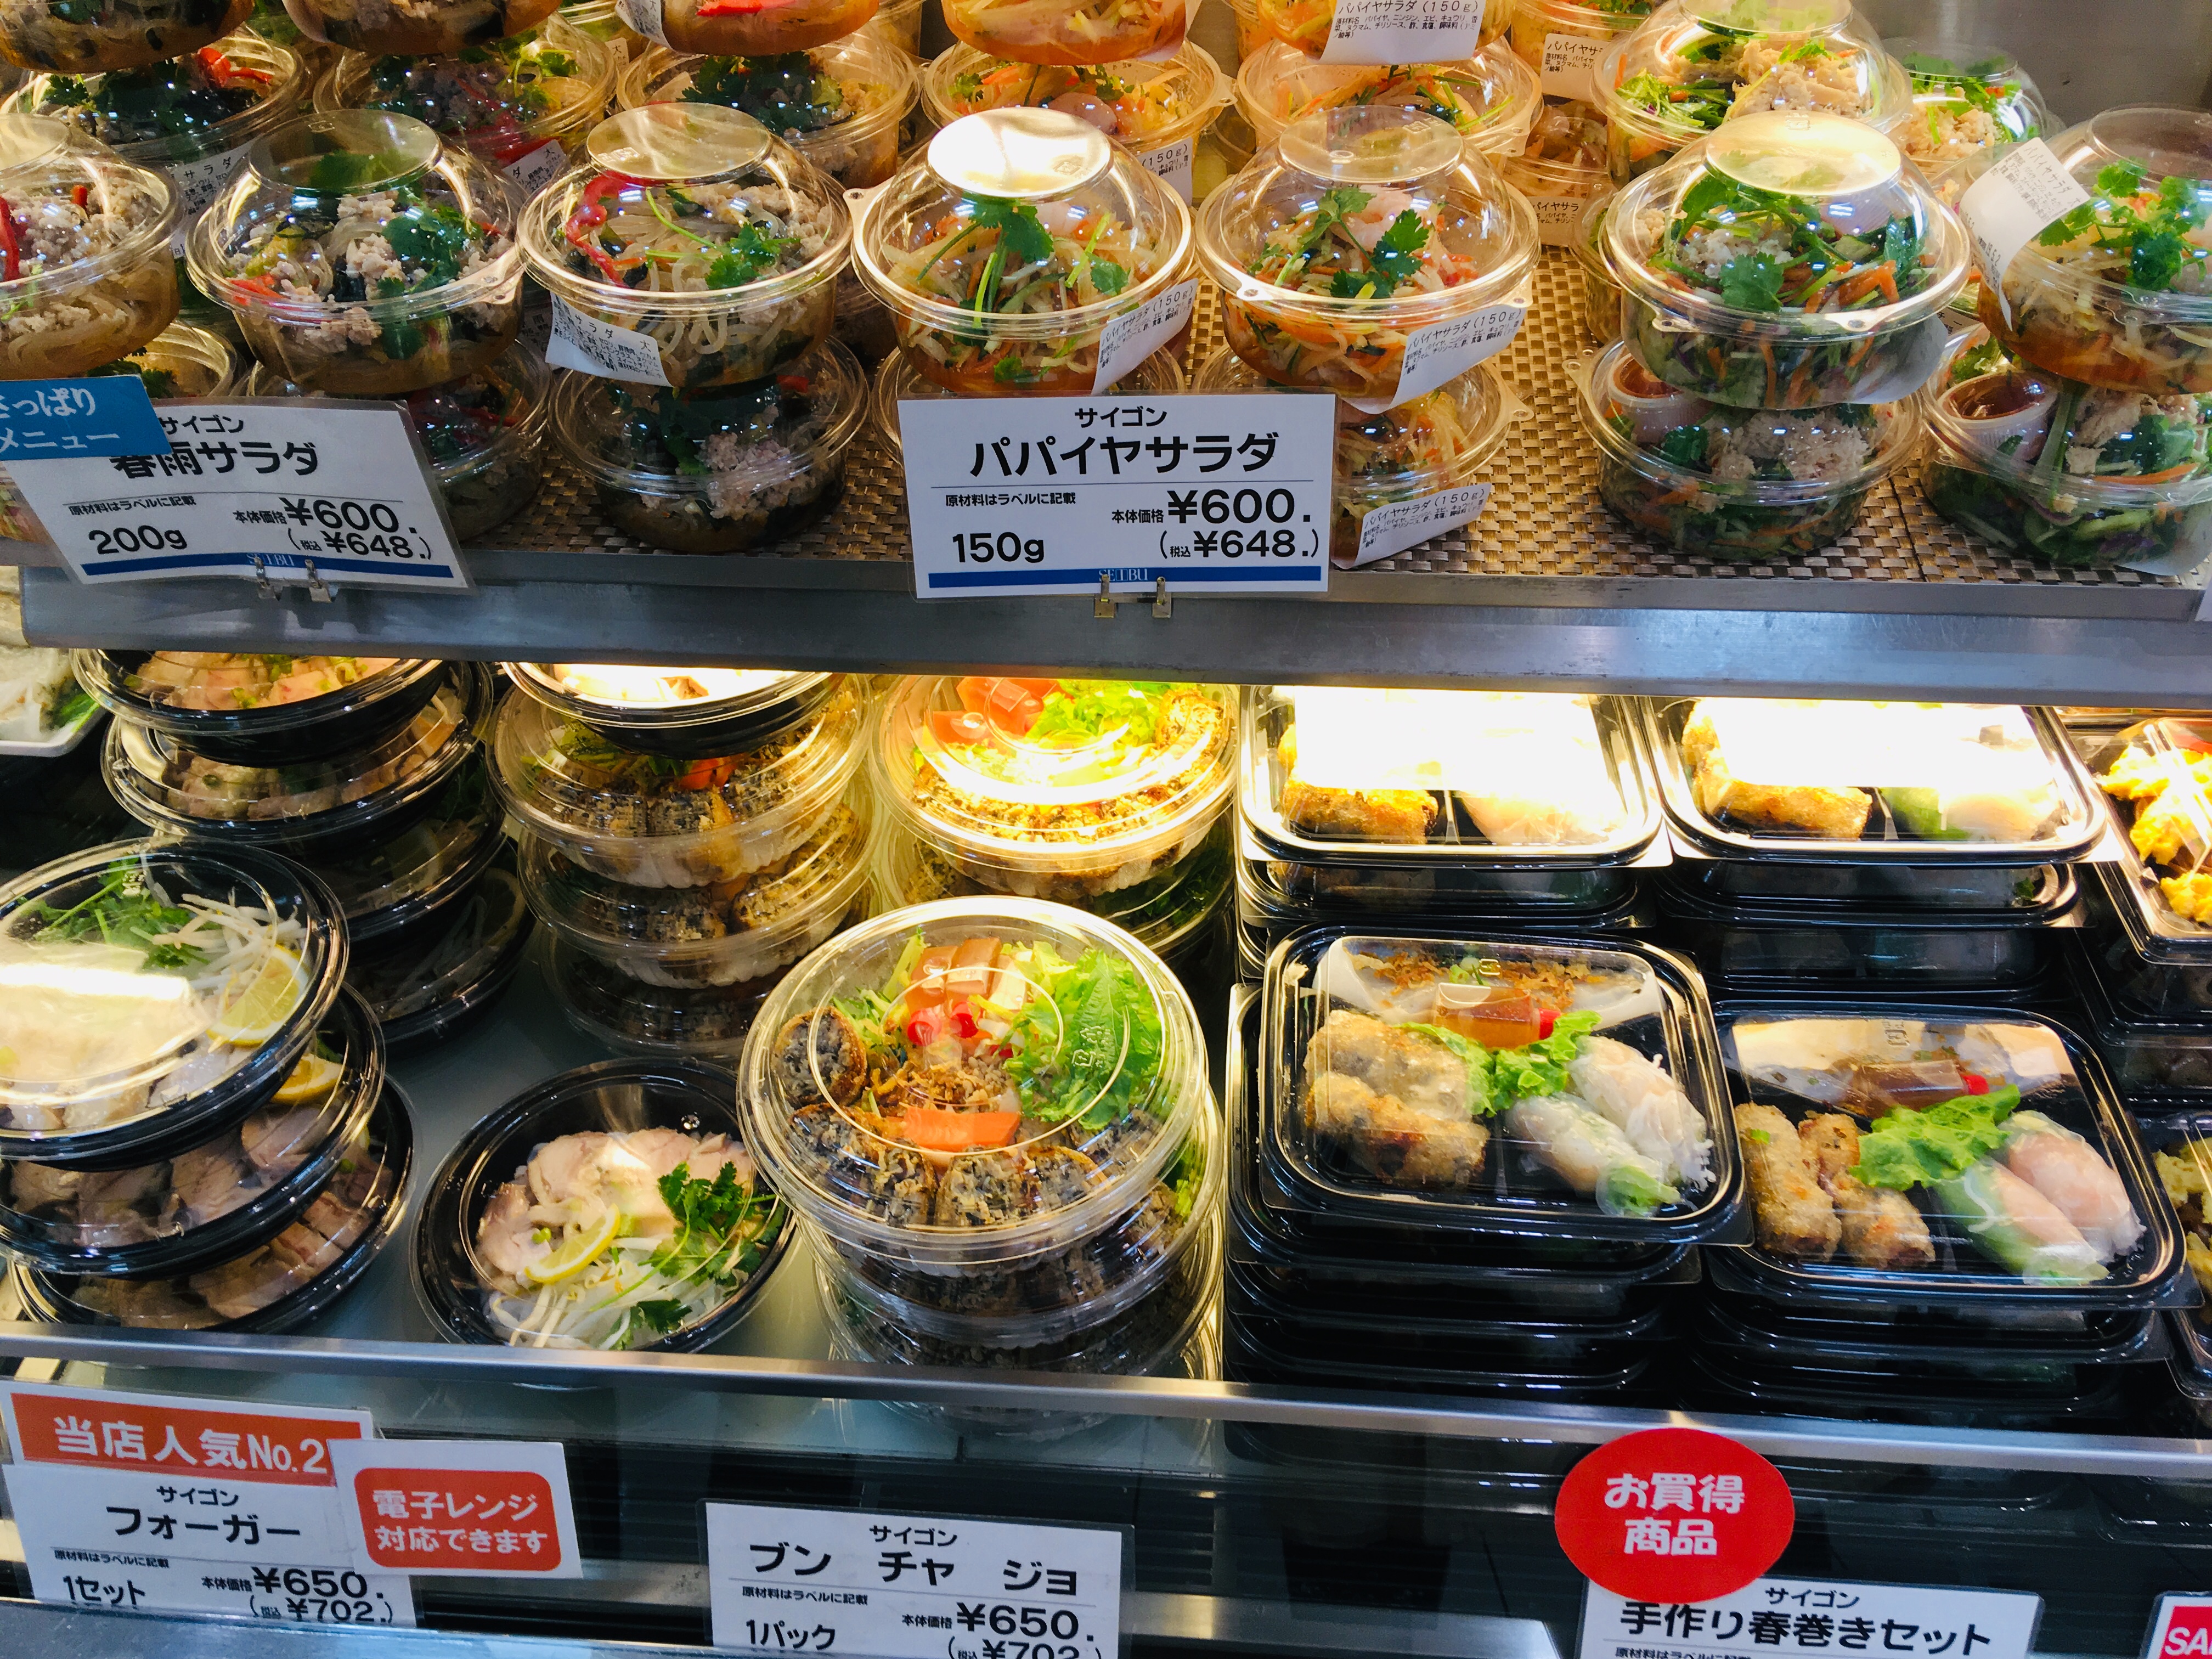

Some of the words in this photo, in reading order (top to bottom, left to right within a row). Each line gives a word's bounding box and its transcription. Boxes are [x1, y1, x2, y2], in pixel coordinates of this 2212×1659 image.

[1548, 41, 1603, 55] パパイヤサ
[159, 414, 244, 435] サイゴン
[1074, 407, 1167, 427] サイゴン
[109, 442, 318, 479] 春雨サラダ
[969, 431, 1280, 477] パパイヤサラダ
[68, 495, 197, 516] 原材料はラベルに記載
[945, 492, 1076, 508] 原材料はラベルに記載
[233, 510, 287, 525] 本体価格
[1112, 509, 1164, 524] 本体価格
[88, 525, 188, 555] 200g
[952, 531, 1045, 564] 150g
[55, 1416, 327, 1474] 当店人気No.2
[156, 1486, 240, 1507] サイゴン
[372, 1489, 540, 1522] 電子レンジ
[1605, 1472, 1746, 1513] お買得
[105, 1505, 301, 1546] フォーガー
[869, 1525, 958, 1547] サイゴン
[1624, 1519, 1718, 1556] 商品
[375, 1526, 548, 1556] 対応できます
[749, 1542, 832, 1576] ブン
[878, 1550, 955, 1587] チャ
[1003, 1559, 1077, 1596] ジョ
[63, 1576, 145, 1605] 1セット
[201, 1576, 252, 1592] 本体価格
[741, 1585, 869, 1606] 原材料はラベルに記載
[1764, 1585, 1860, 1610] サイゴン
[745, 1618, 837, 1651] 1パック
[901, 1614, 952, 1630] 本体価格
[1619, 1602, 1991, 1656] 手作り春巻きセット
[2164, 1627, 2212, 1656] SA
